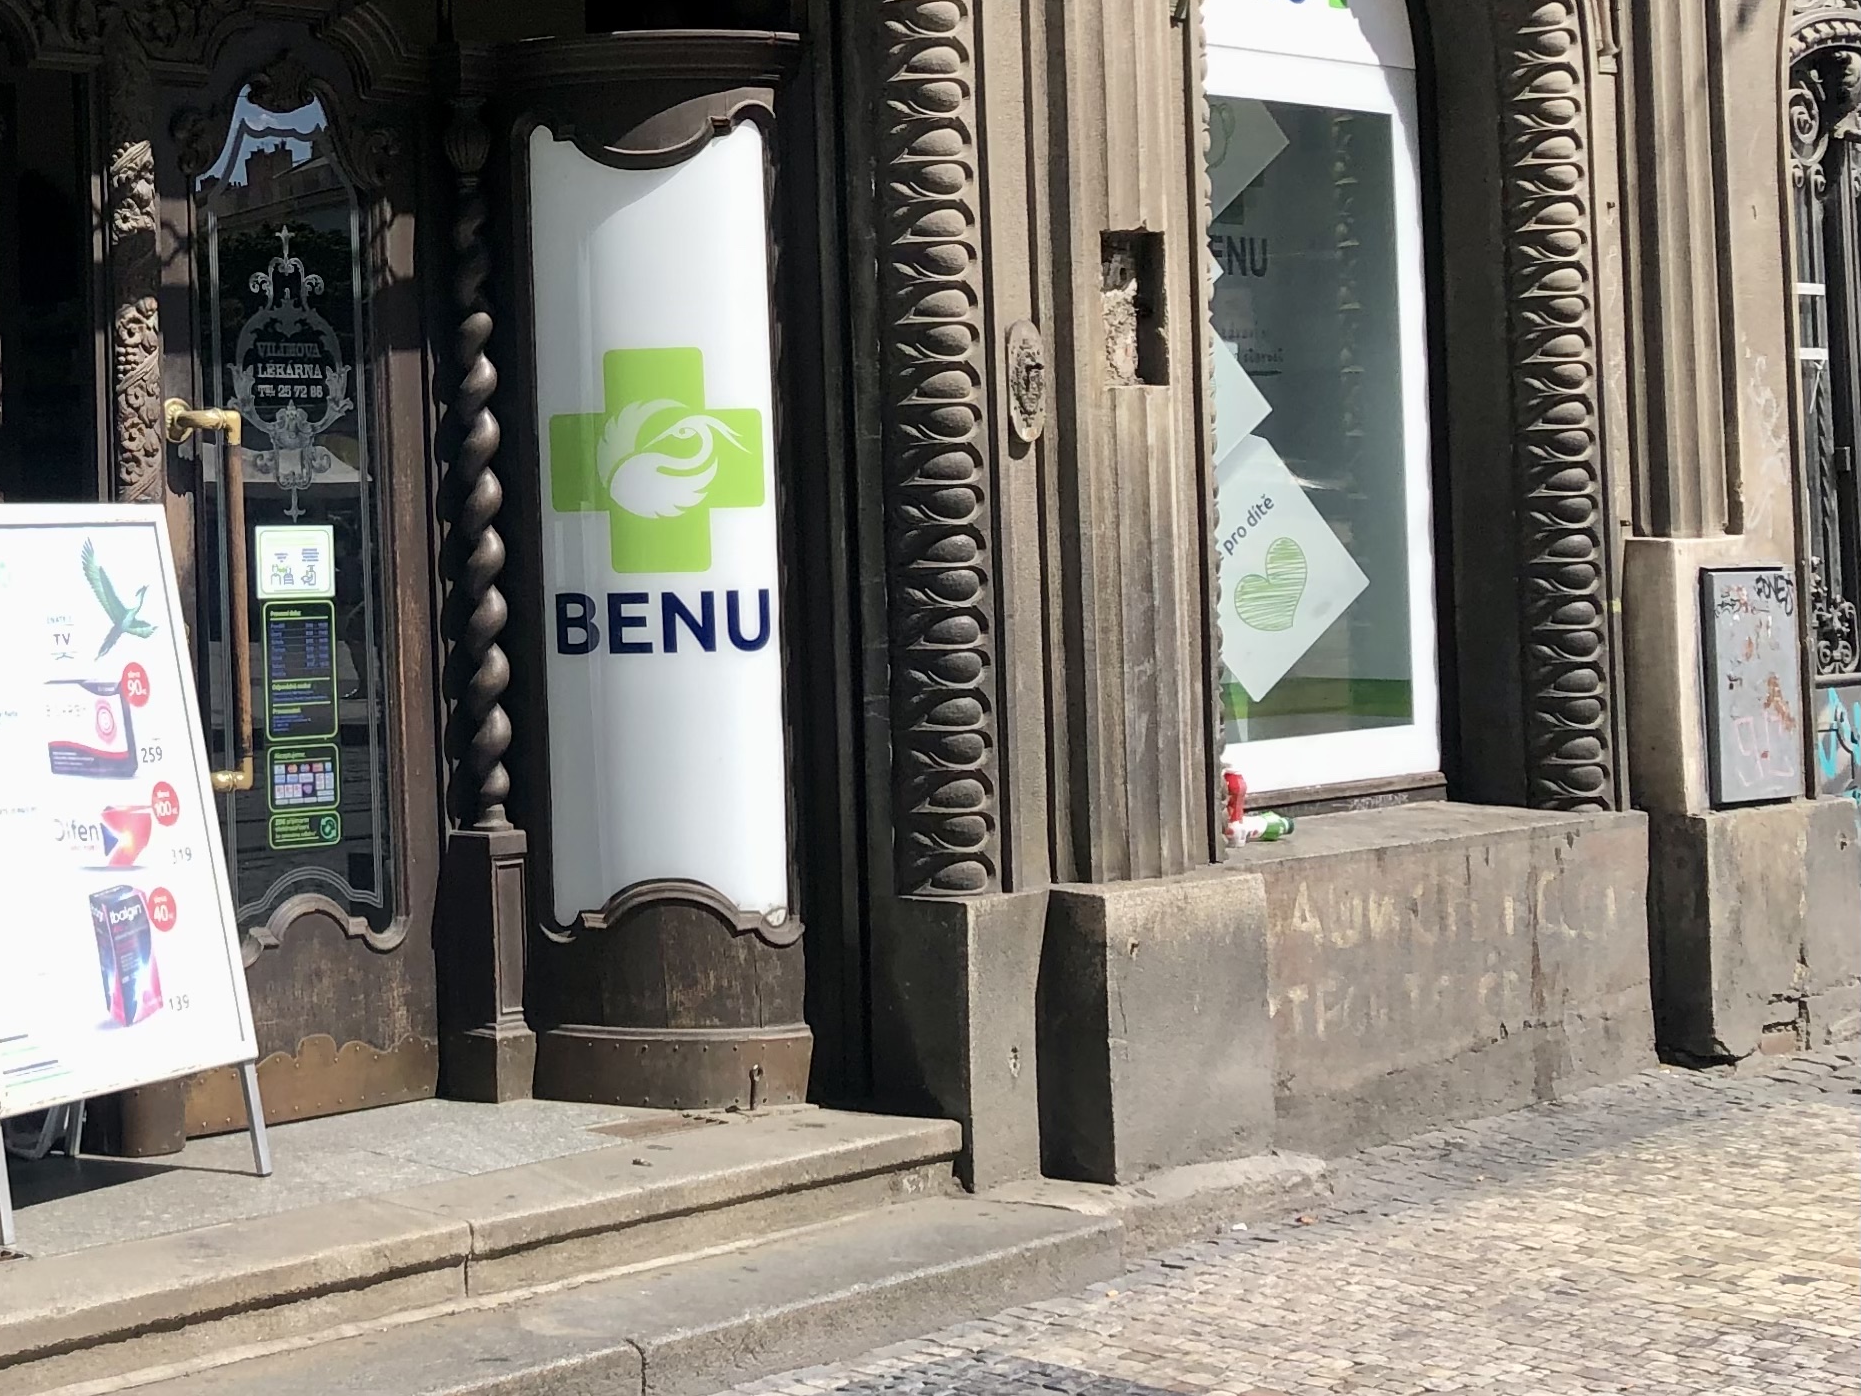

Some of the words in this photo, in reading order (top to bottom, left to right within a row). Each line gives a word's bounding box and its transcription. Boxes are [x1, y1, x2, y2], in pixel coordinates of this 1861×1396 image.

[257, 360, 323, 379] LÉKÁRNA
[1223, 526, 1247, 556] pro
[1247, 493, 1274, 527] dítě
[555, 589, 771, 654] BENU
[141, 746, 163, 764] 259
